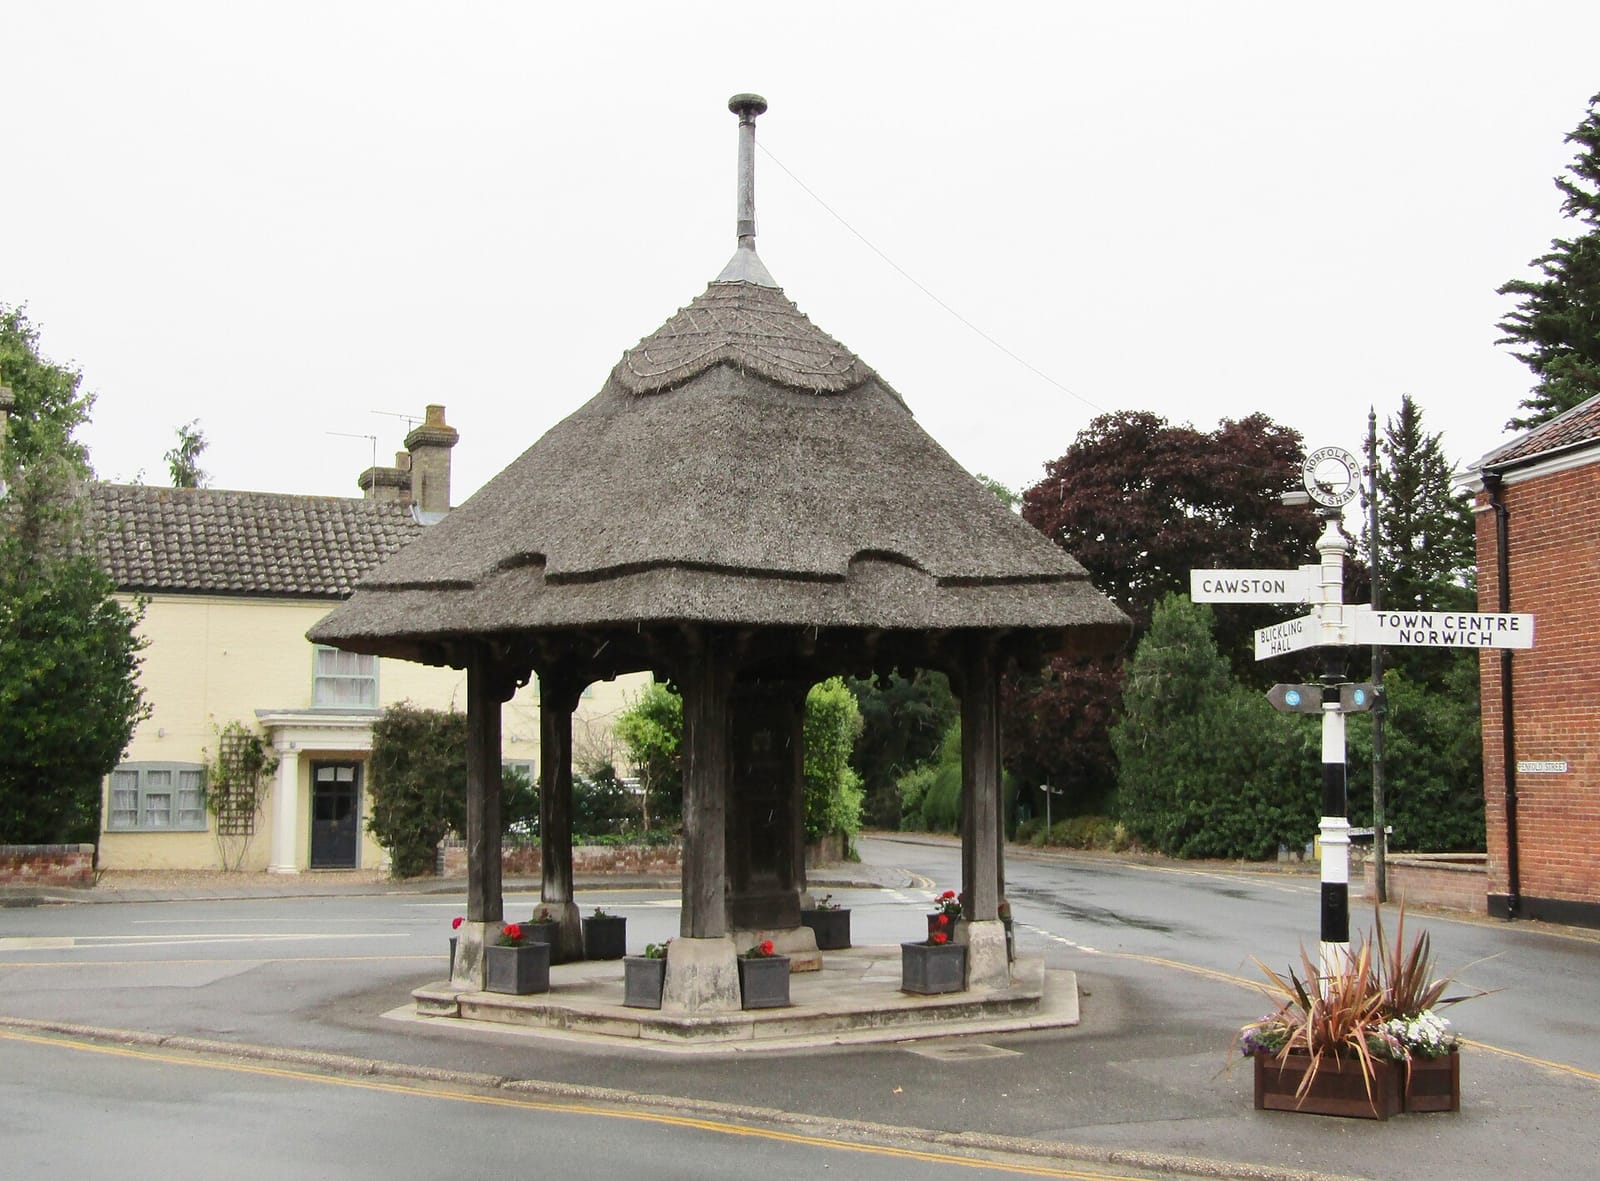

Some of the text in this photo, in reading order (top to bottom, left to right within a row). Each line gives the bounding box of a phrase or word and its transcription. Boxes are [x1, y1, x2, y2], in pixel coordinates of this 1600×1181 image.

[1306, 449, 1349, 473] NORFOLK
[1309, 486, 1356, 506] AYLSHAM
[1203, 580, 1285, 594] CAWSTON
[1377, 614, 1520, 631] TOWN CENTRE
[1260, 620, 1302, 643] BLICKLING
[1399, 629, 1493, 645] NORWICH
[1271, 638, 1292, 654] HALL
